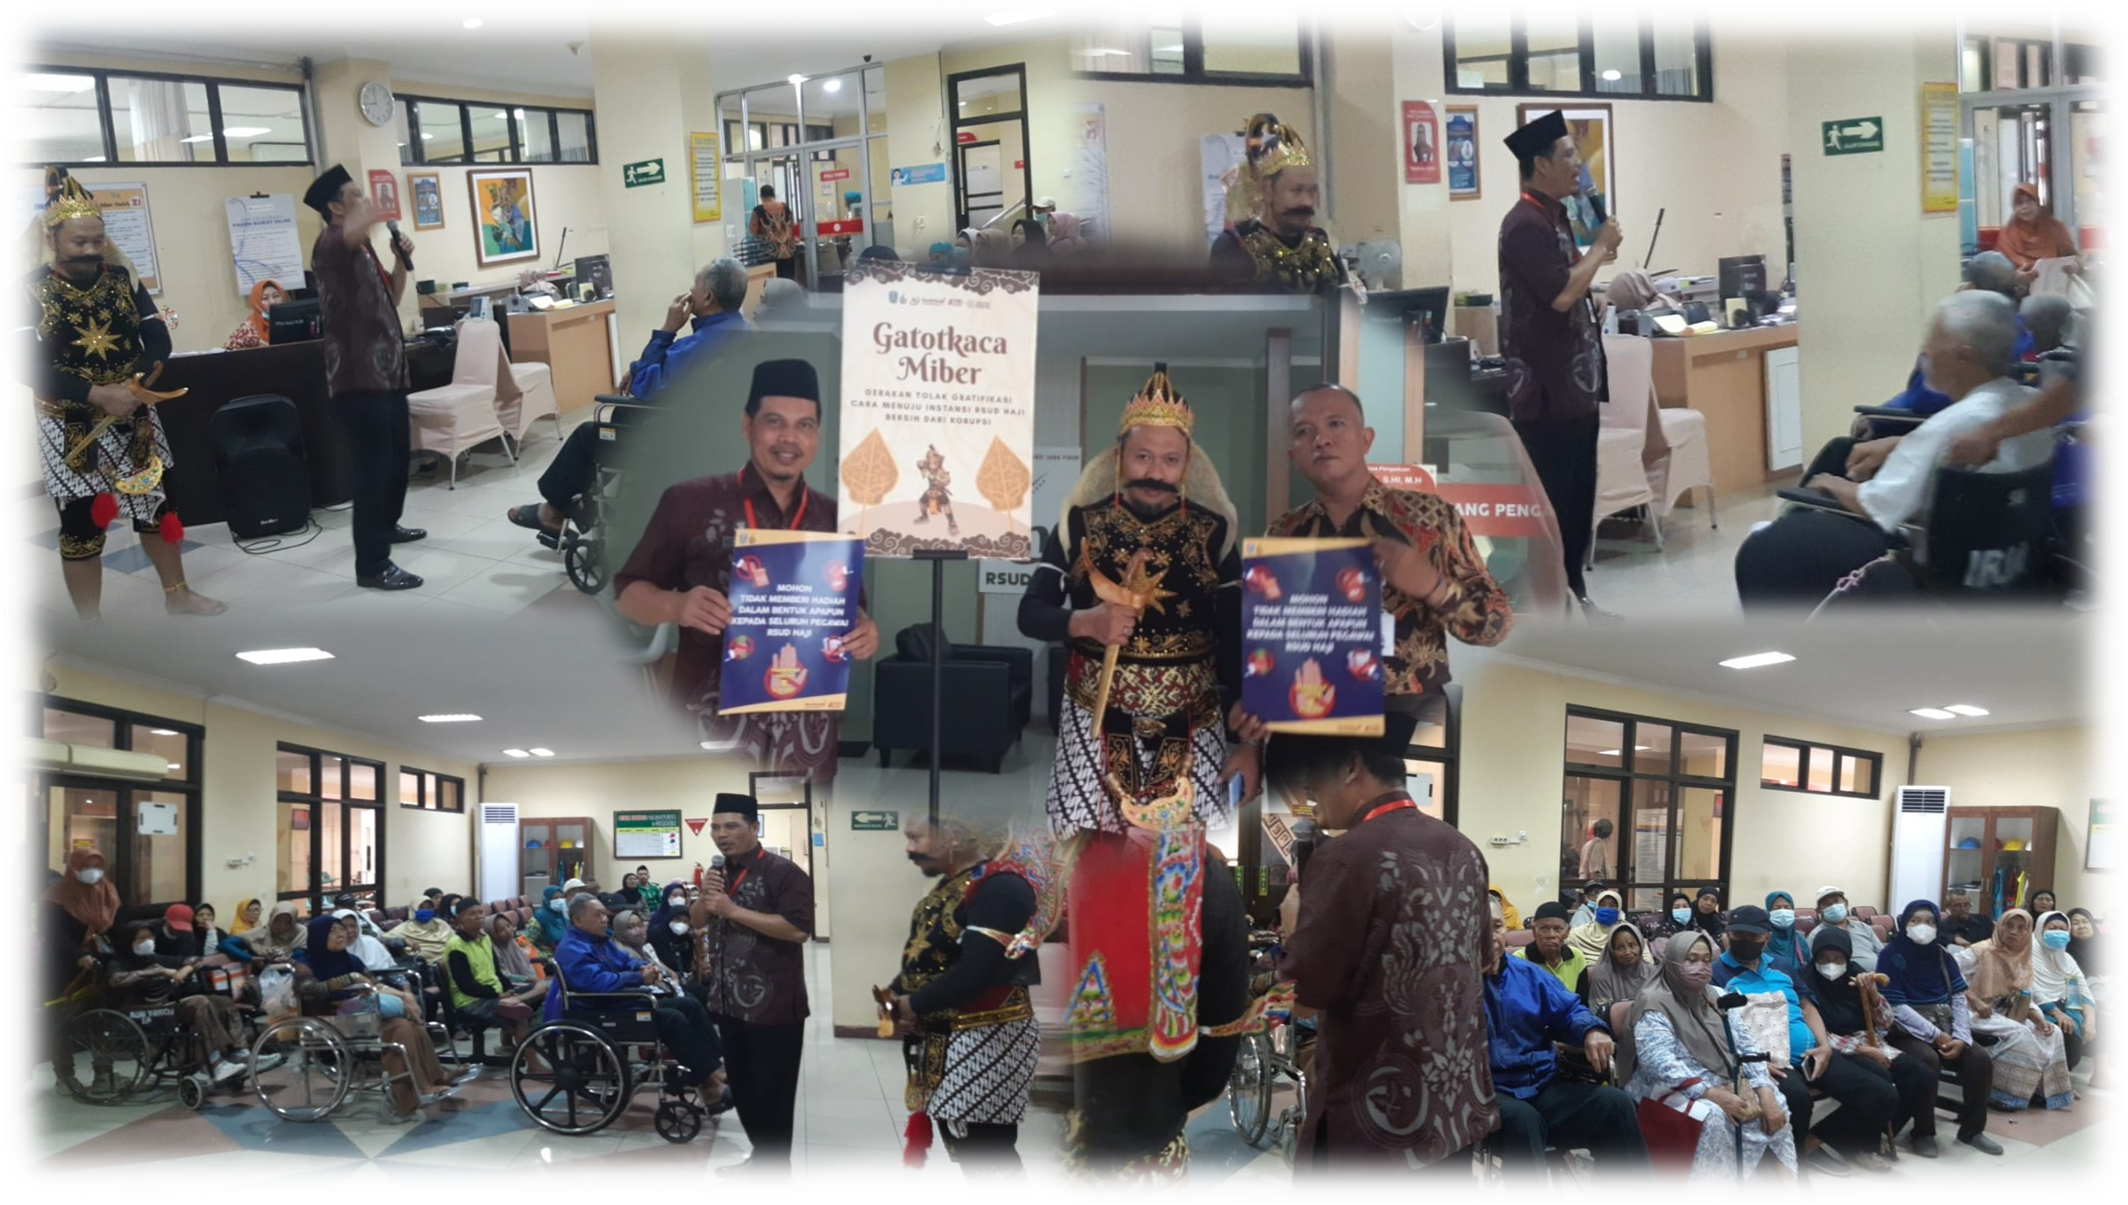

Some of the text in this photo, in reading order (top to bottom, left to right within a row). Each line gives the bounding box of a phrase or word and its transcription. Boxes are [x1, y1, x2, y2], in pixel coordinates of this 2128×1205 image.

[873, 321, 1008, 358] Gatotkaca
[896, 352, 983, 385] Miber
[864, 388, 1013, 404] GERAKAN TOLAK GRATIFIKASI
[850, 399, 1026, 416] CARA MENUJU INSTANSI RSUD HAJI
[885, 413, 992, 426] BERSIH DARI KORUPSI
[985, 572, 1031, 586] RSUD
[776, 584, 813, 593] MOHON
[740, 594, 846, 605] TIDAK MEMBERI HADIAH
[738, 606, 845, 616] DALAM BENTUK APAPUN
[731, 617, 849, 627] KEPADA SELURUH PEGAWAI
[766, 628, 813, 638] RSUD HAJI
